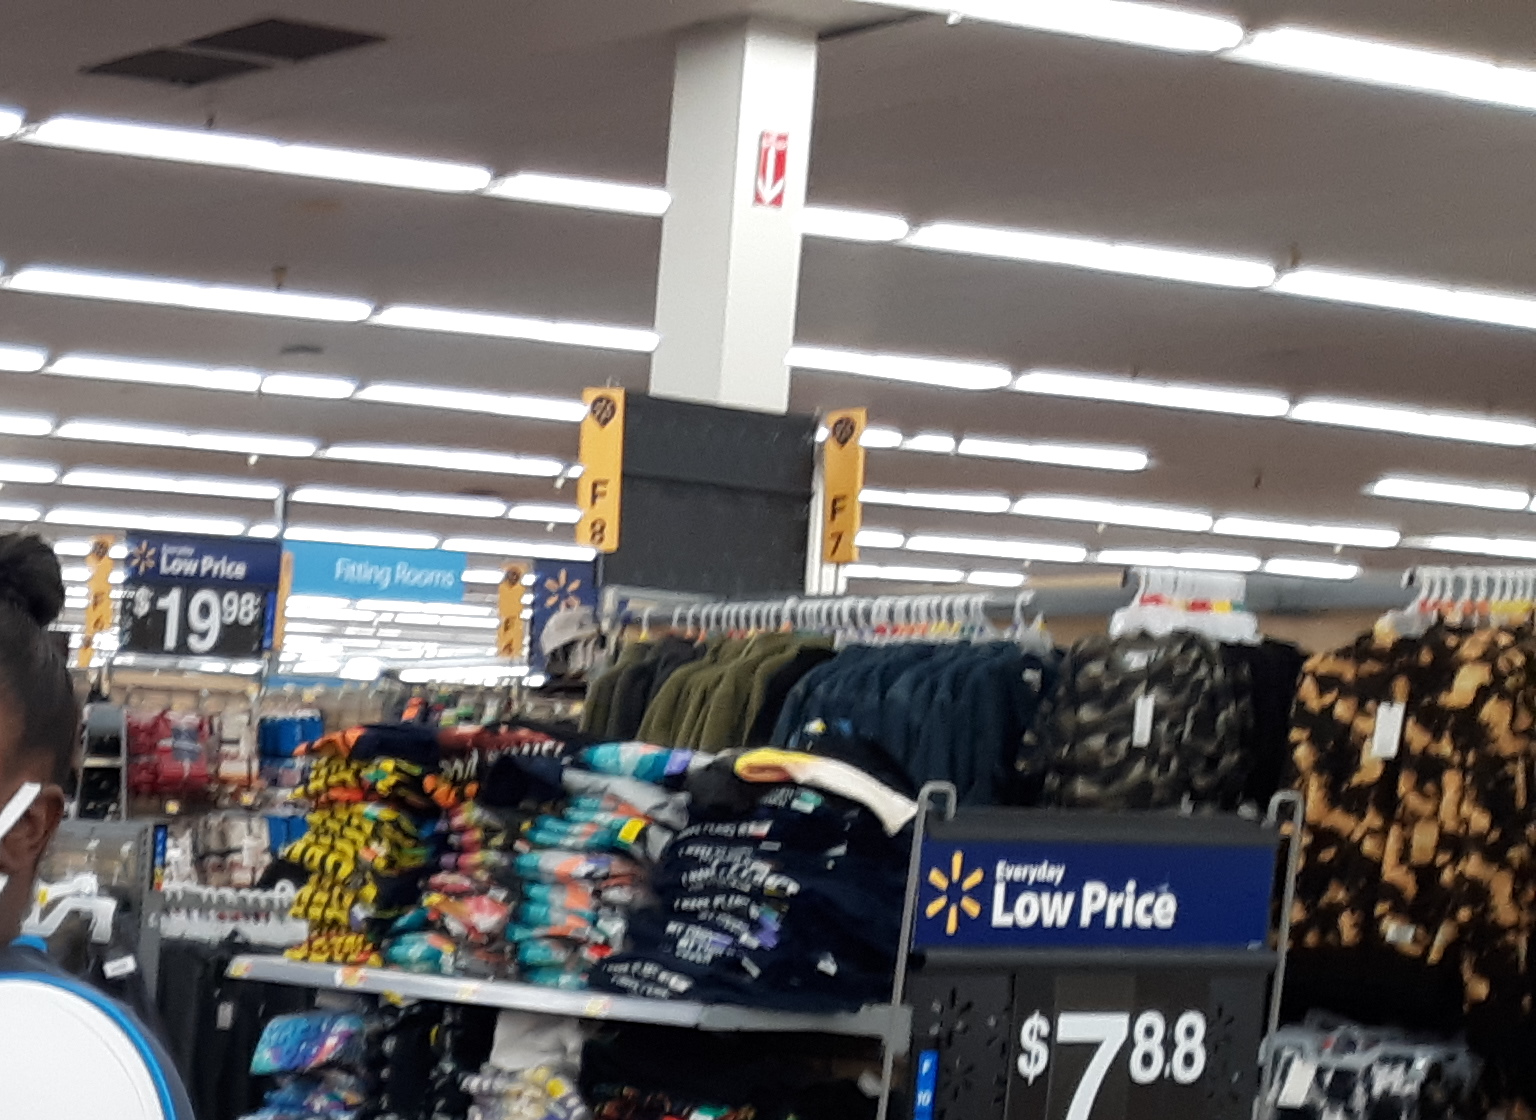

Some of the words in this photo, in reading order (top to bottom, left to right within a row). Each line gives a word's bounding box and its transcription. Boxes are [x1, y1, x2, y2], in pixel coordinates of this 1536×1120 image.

[159, 552, 199, 576] Low
[200, 555, 247, 580] Price
[334, 557, 392, 590] Fitting
[394, 561, 455, 589] Rooms
[996, 859, 1065, 886] Everyday
[991, 882, 1077, 928] Low
[1079, 880, 1177, 930] Price
